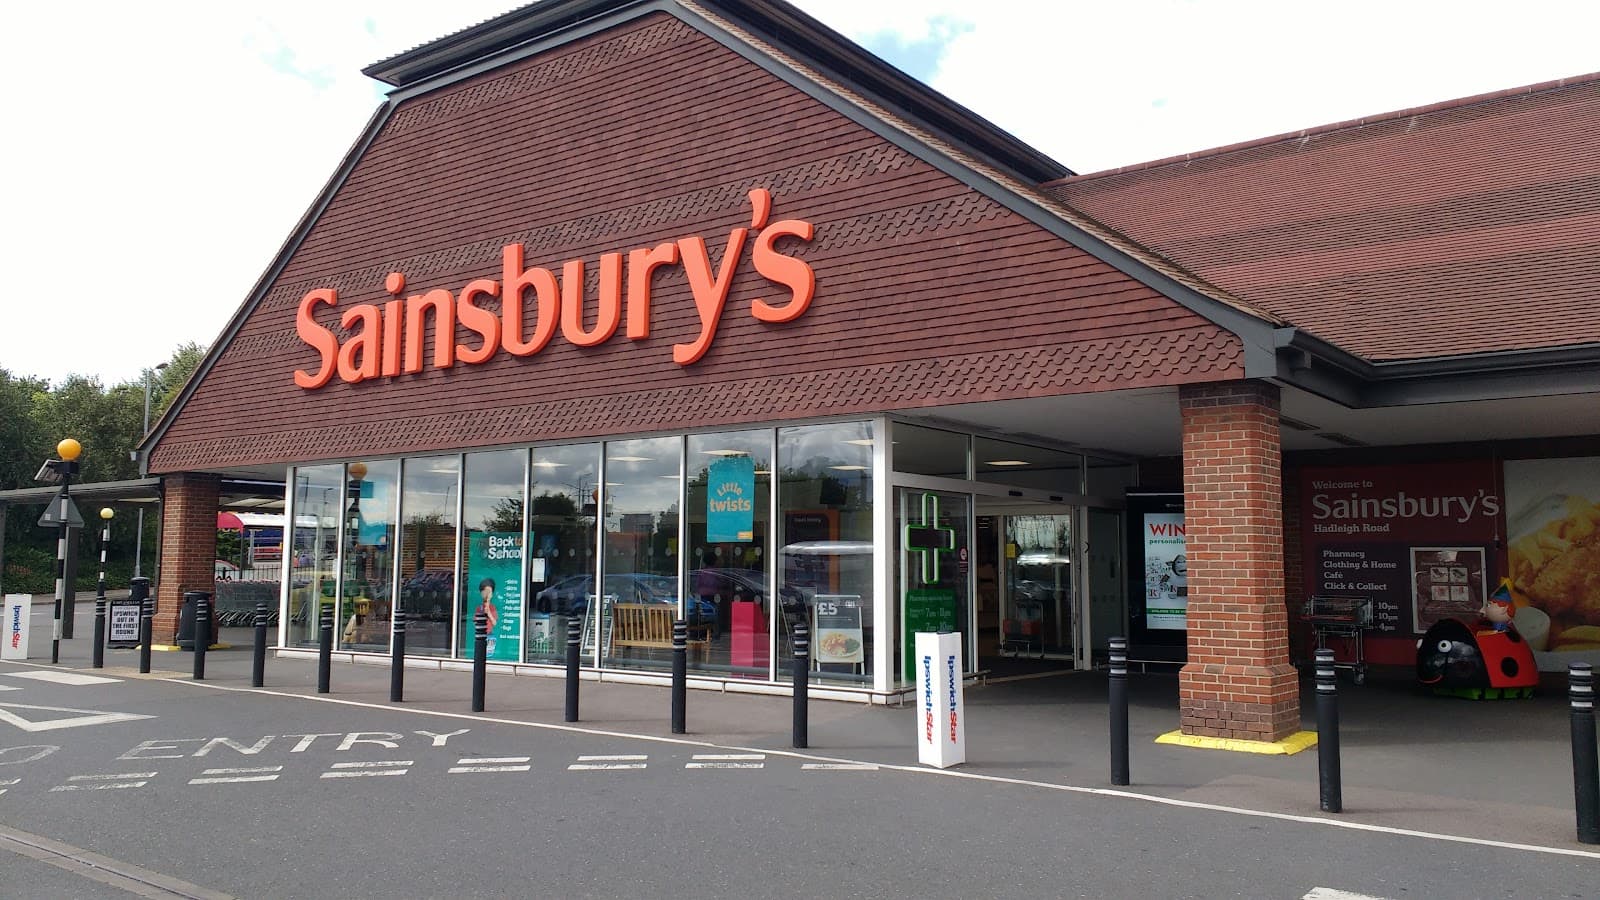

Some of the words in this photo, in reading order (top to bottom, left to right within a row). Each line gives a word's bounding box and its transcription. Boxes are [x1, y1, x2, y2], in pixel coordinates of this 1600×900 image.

[293, 188, 816, 389] Sainsbury's
[717, 482, 743, 496] Little
[1312, 481, 1360, 490] Welcome
[1362, 480, 1373, 488] to
[710, 497, 751, 512] twists
[1312, 489, 1500, 523] Sainsbury's
[1149, 523, 1186, 536] WIN
[1314, 525, 1360, 534] Hadleigh
[1362, 523, 1390, 532] Road
[489, 536, 514, 547] Back
[515, 537, 523, 546] to
[1323, 550, 1365, 559] Pharmacy
[1323, 561, 1360, 570] Clothing
[1362, 561, 1369, 569] &
[1371, 561, 1397, 569] Home
[1324, 571, 1344, 579] Café
[818, 602, 838, 615] £5
[1378, 602, 1399, 610] 10pm
[1378, 613, 1399, 621] 10pm
[115, 728, 472, 761] ENTRY
